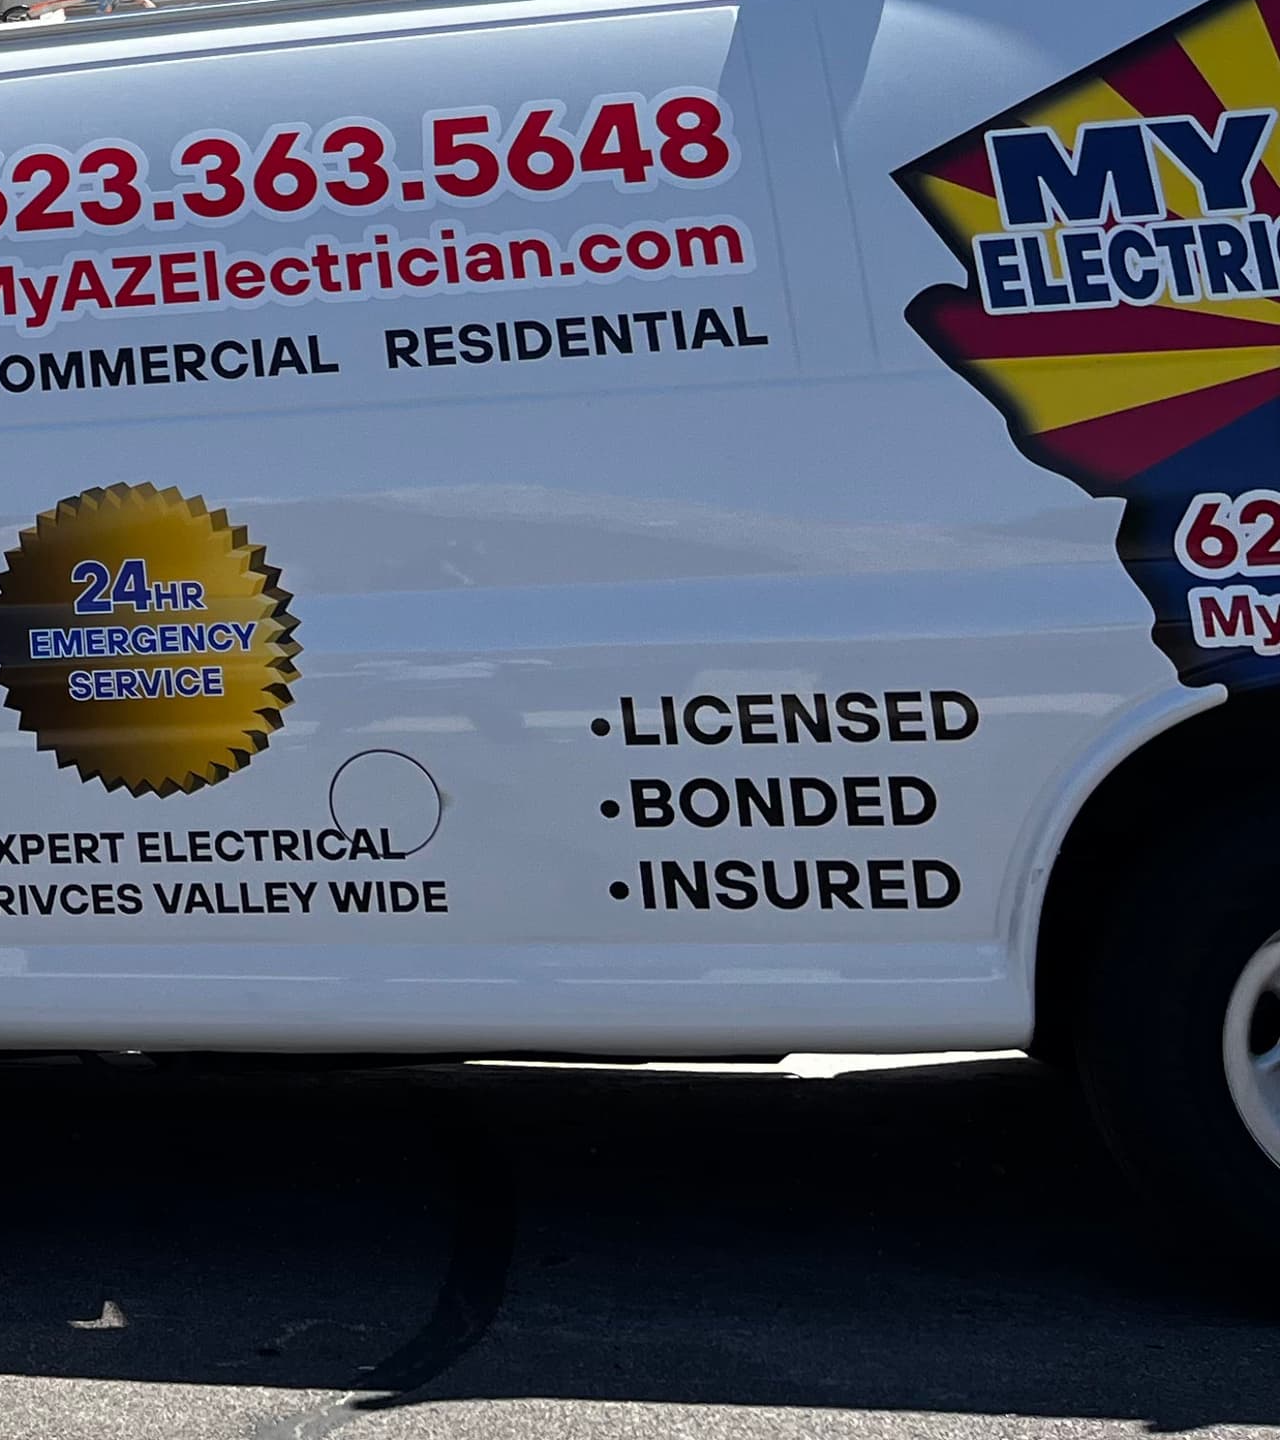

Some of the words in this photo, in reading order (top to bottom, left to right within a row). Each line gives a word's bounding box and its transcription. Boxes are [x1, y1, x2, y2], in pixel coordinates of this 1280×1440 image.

[987, 111, 1273, 226] MY
[978, 220, 1280, 310] ELECTRI
[386, 305, 769, 369] RESIDENTIAL
[29, 621, 258, 659] EMERGENCY
[68, 667, 224, 701] SERVICE
[619, 690, 980, 746] LICENSED
[630, 775, 938, 829] BONDED
[137, 827, 407, 863] ELECTRICAL
[153, 881, 319, 914] VALLEY
[328, 879, 449, 914] WIDE
[639, 859, 962, 910] INSURED
